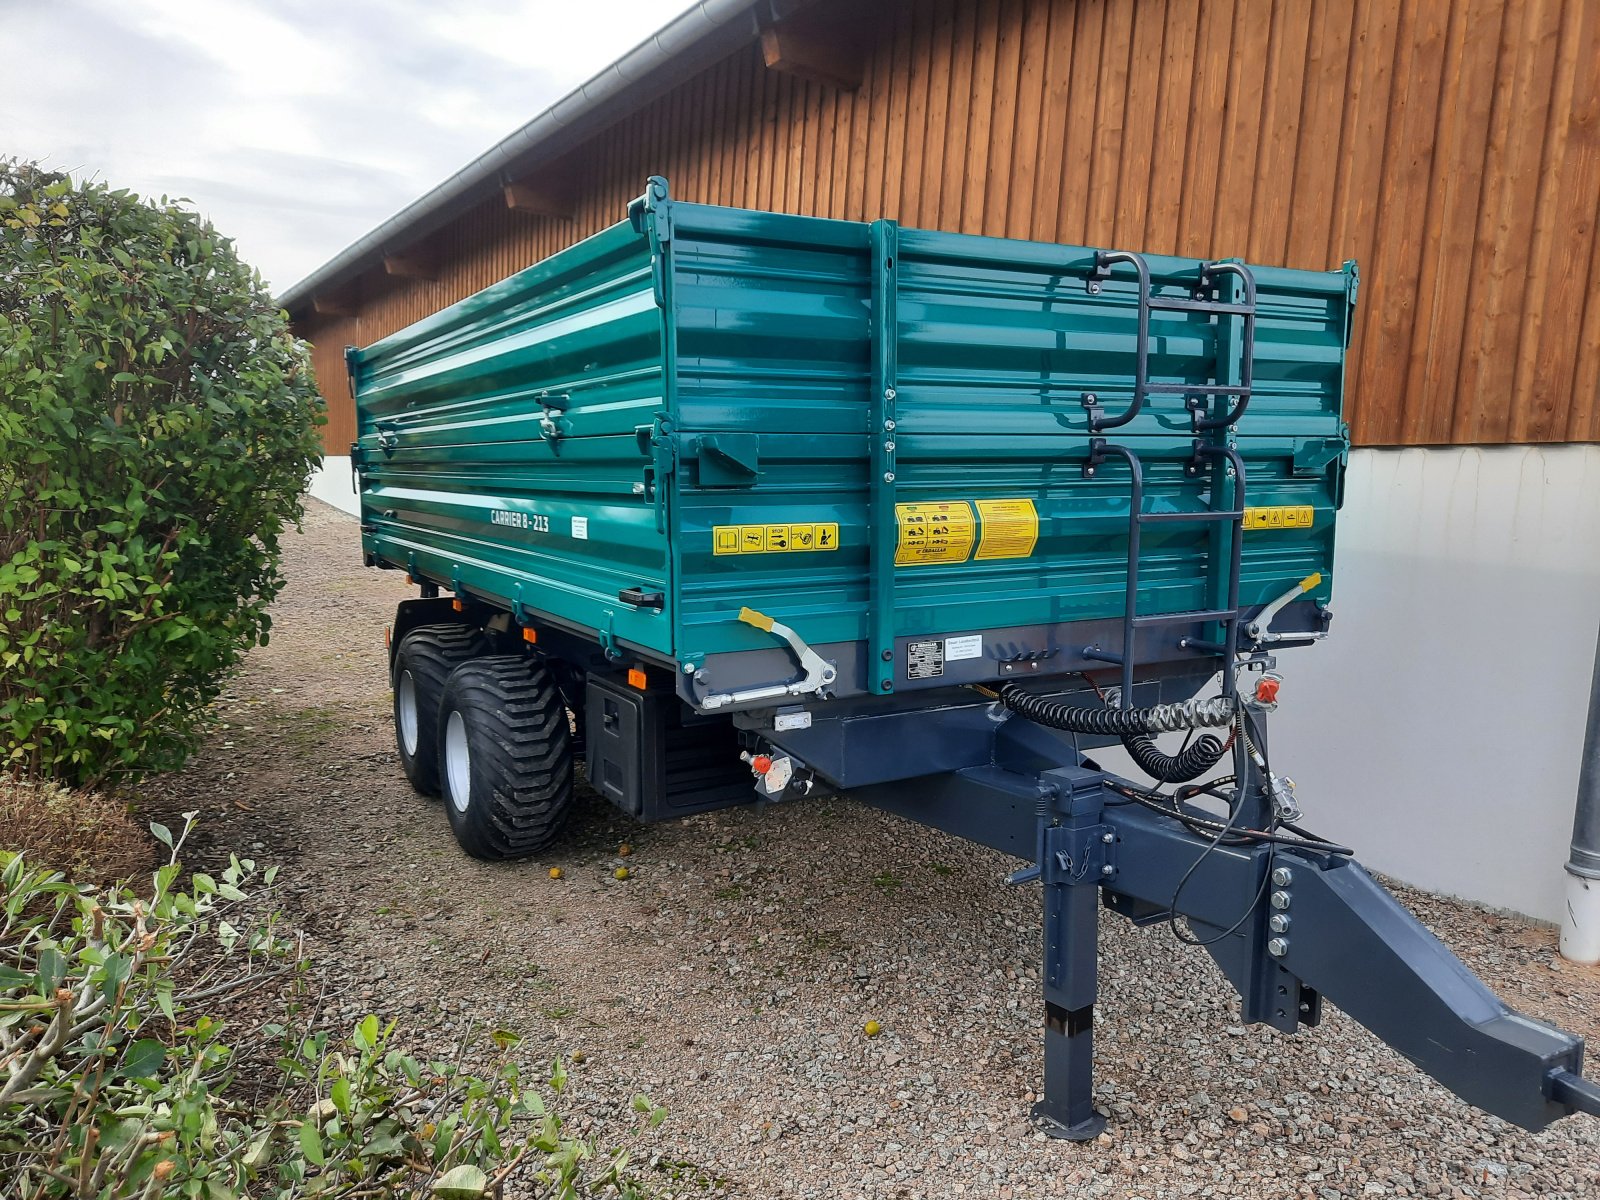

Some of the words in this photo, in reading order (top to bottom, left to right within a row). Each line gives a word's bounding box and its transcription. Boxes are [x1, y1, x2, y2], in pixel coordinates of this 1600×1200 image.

[491, 510, 521, 528] CARRIER
[522, 513, 528, 529] 8
[533, 514, 549, 533] 213
